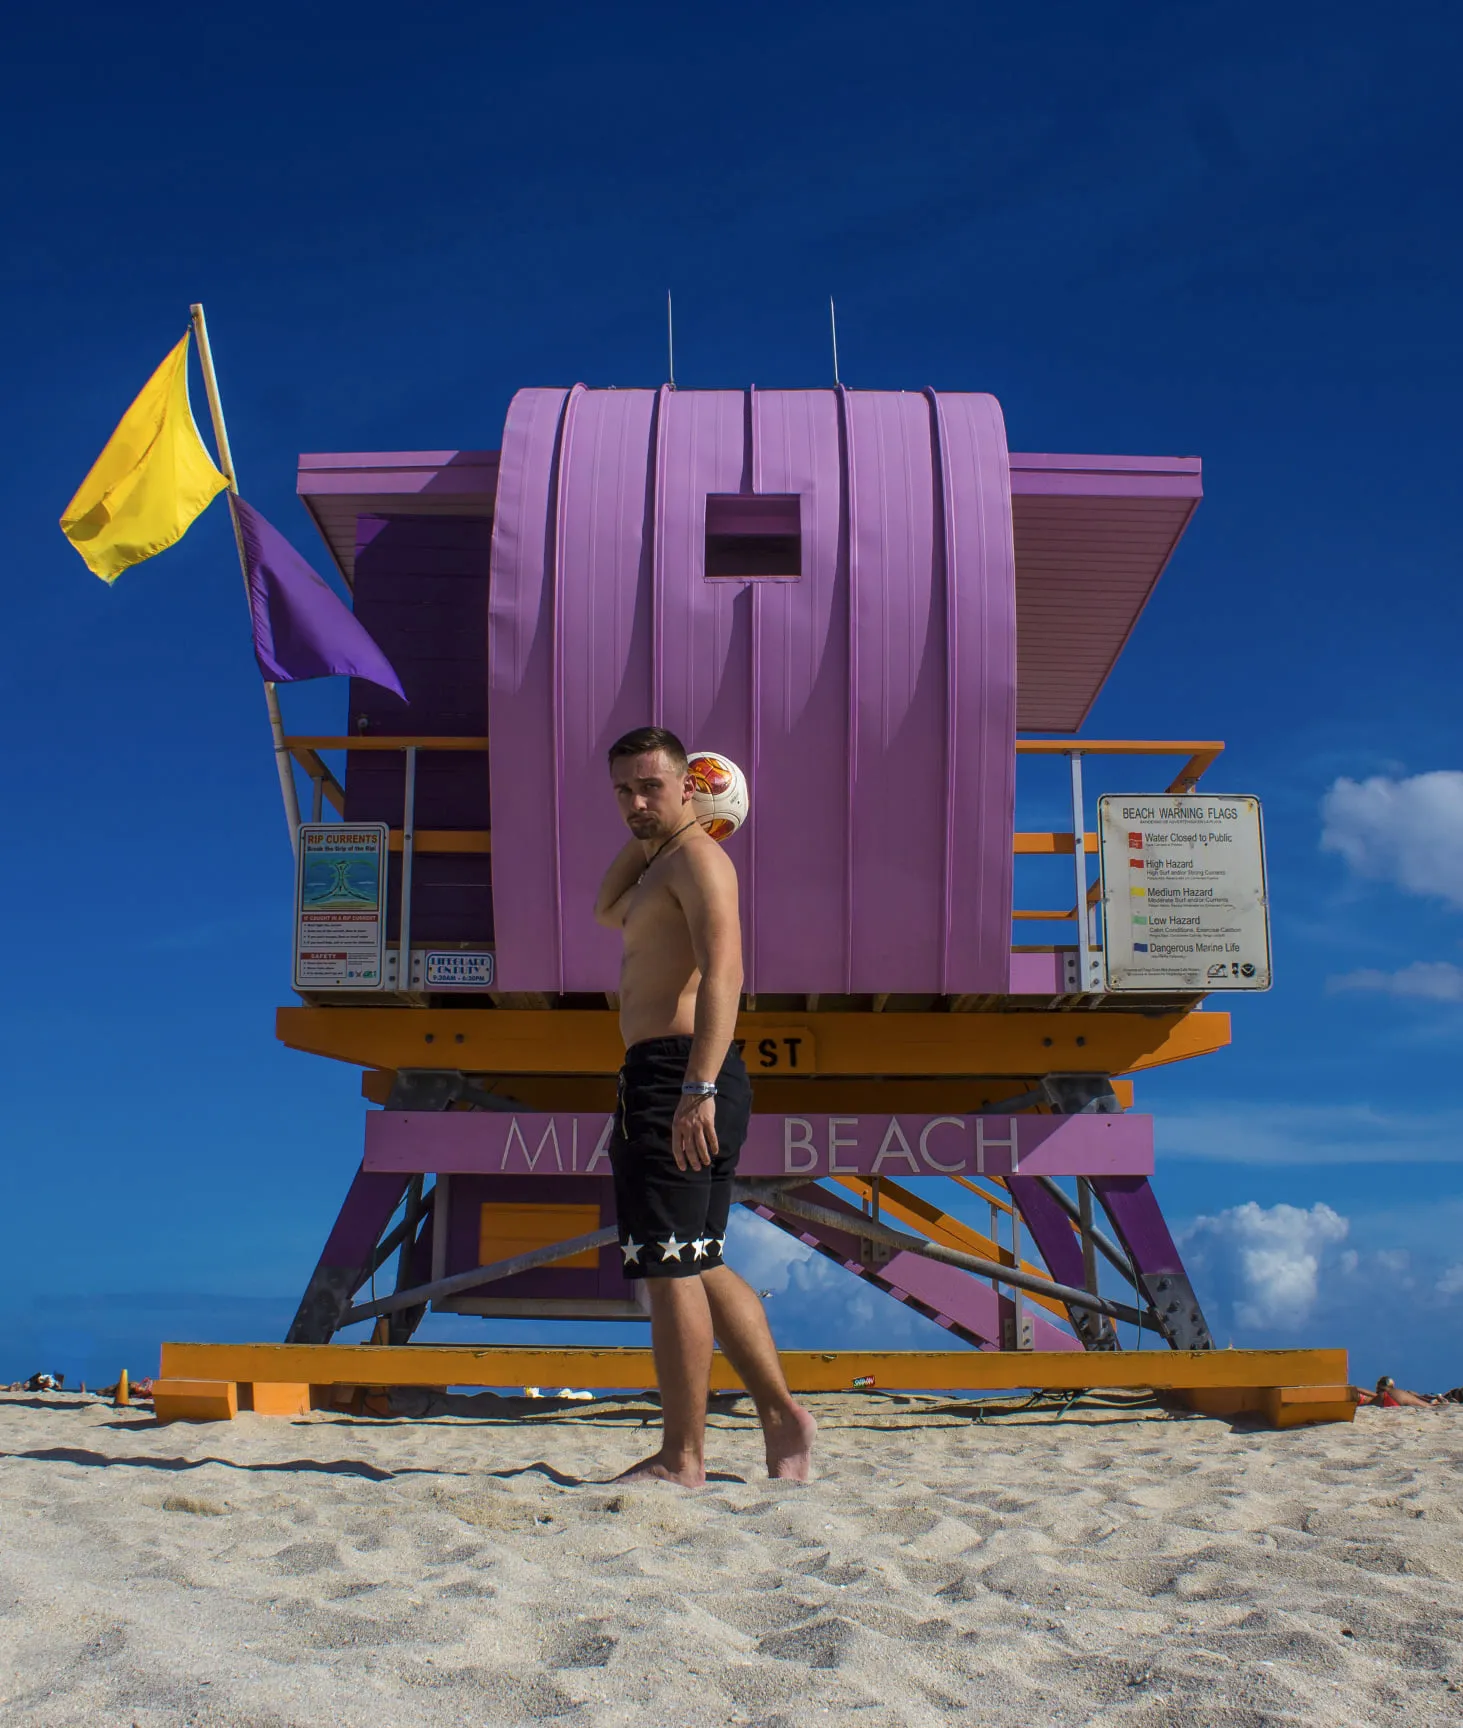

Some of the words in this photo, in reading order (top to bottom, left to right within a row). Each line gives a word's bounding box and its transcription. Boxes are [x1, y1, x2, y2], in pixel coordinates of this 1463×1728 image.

[1122, 807, 1155, 819] BEACH
[1159, 807, 1204, 819] WARNING
[1207, 808, 1238, 820] FLAGS
[307, 834, 324, 844] RIP
[326, 834, 378, 844] CURRENTS
[1144, 833, 1167, 843] Water
[1169, 833, 1197, 843] Closed
[1199, 833, 1207, 843] to
[1208, 833, 1232, 843] Public
[1146, 859, 1164, 871] High
[1165, 859, 1194, 869] Hazard
[1147, 887, 1181, 897] Medium
[1182, 887, 1214, 897] Hazard
[1148, 915, 1167, 925] Low
[1168, 915, 1201, 925] Hazard
[1150, 943, 1194, 954] Dangerous
[1195, 943, 1223, 953] Marine
[1224, 943, 1241, 953] Life
[758, 1038, 802, 1068] ST
[500, 1116, 615, 1172] MIA
[784, 1115, 1019, 1173] BEACH
